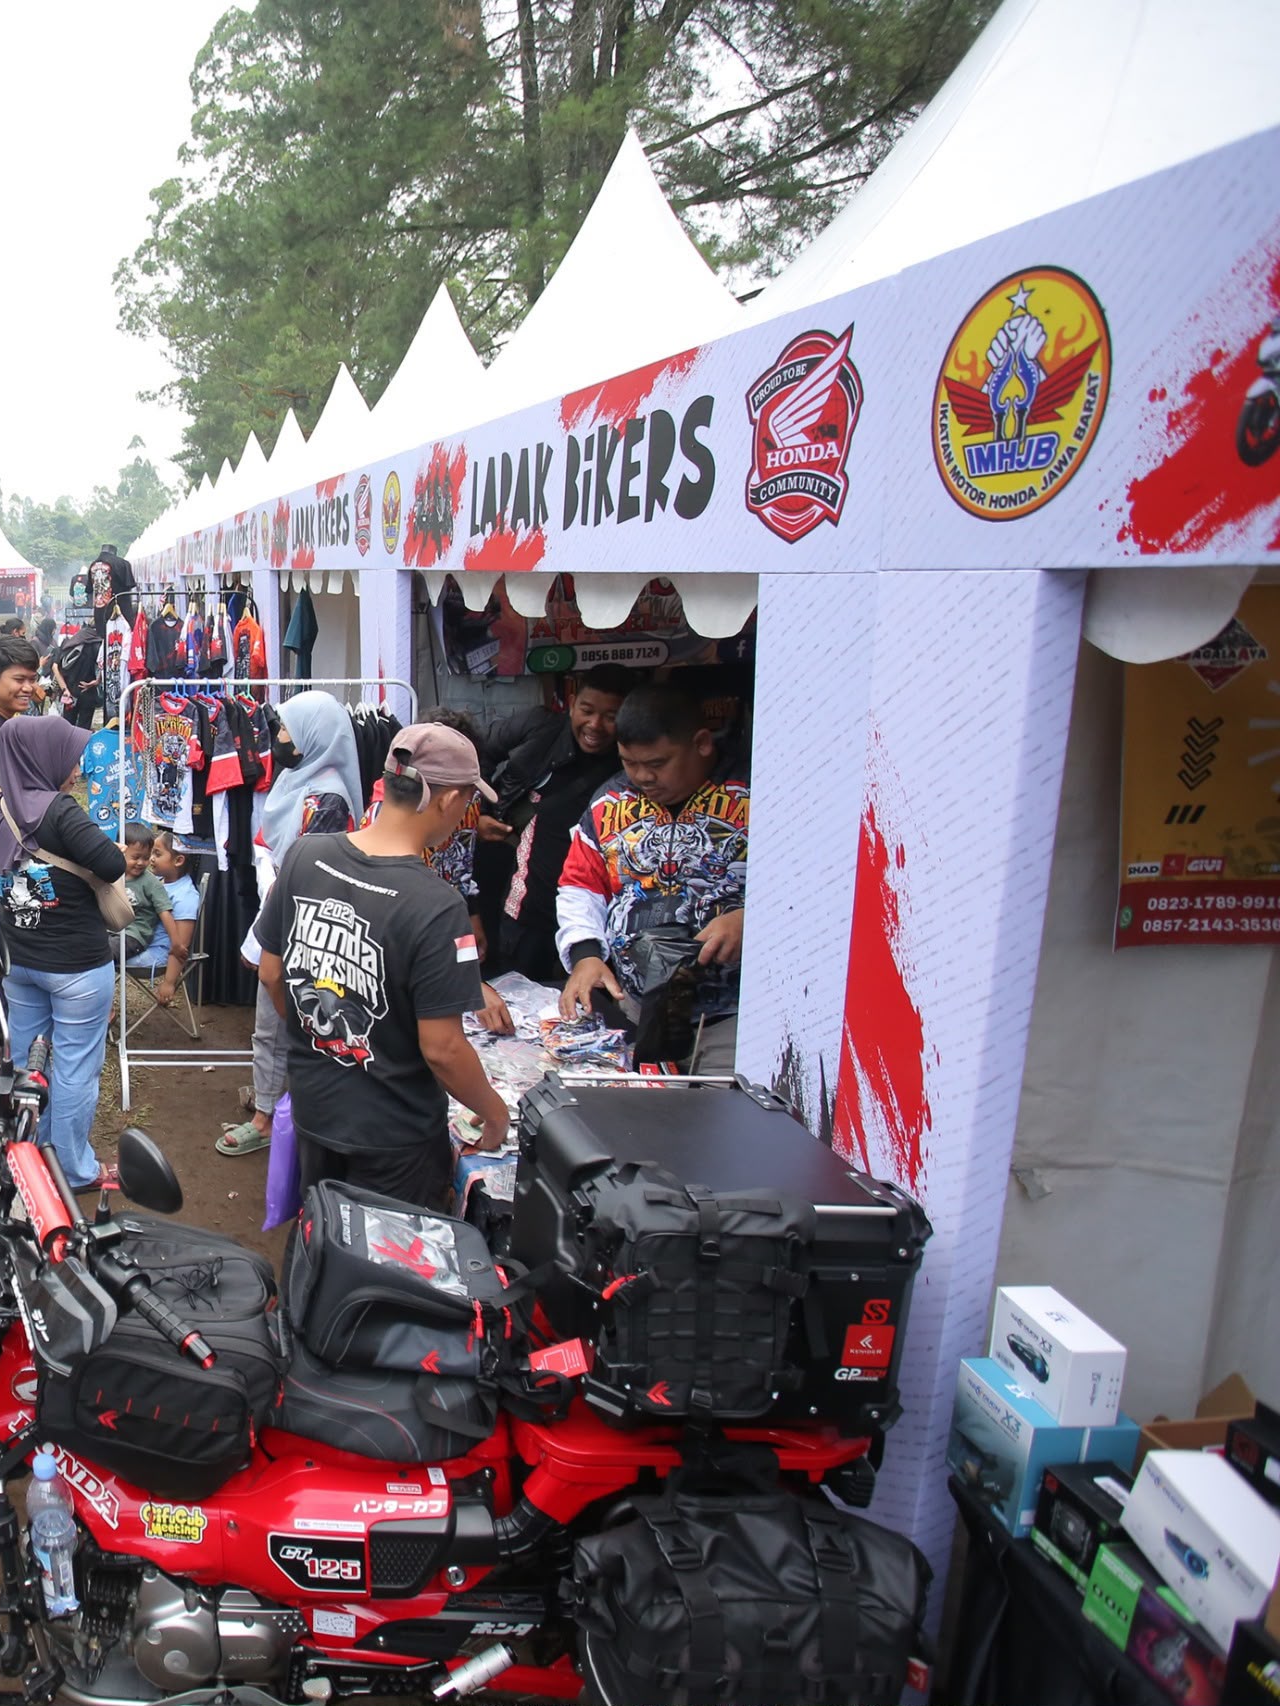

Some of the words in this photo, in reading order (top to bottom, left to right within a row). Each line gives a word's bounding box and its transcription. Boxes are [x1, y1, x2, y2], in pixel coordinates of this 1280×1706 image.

[753, 373, 785, 407] PROUD
[782, 367, 795, 381] TO
[795, 363, 807, 377] BE
[938, 403, 954, 466] IKATAN
[949, 466, 987, 507] MOTOR
[989, 486, 1038, 509] HONDA
[1041, 446, 1078, 491] JAWA
[1073, 371, 1101, 442] BARAT
[765, 441, 841, 469] HONDA
[966, 434, 1058, 477] IMHJB
[469, 441, 554, 538] LAPAK
[759, 475, 836, 501] COMMUNITY
[292, 502, 315, 550] LAPAK
[581, 648, 609, 662] 0856
[611, 647, 634, 661] 888
[635, 646, 661, 660] 7124
[1128, 864, 1159, 875] SHAD
[1187, 858, 1223, 872] GIVI
[296, 902, 378, 979] Honda
[147, 1522, 200, 1541] Meeting
[279, 1545, 313, 1560] CT
[304, 1558, 362, 1580] 125
